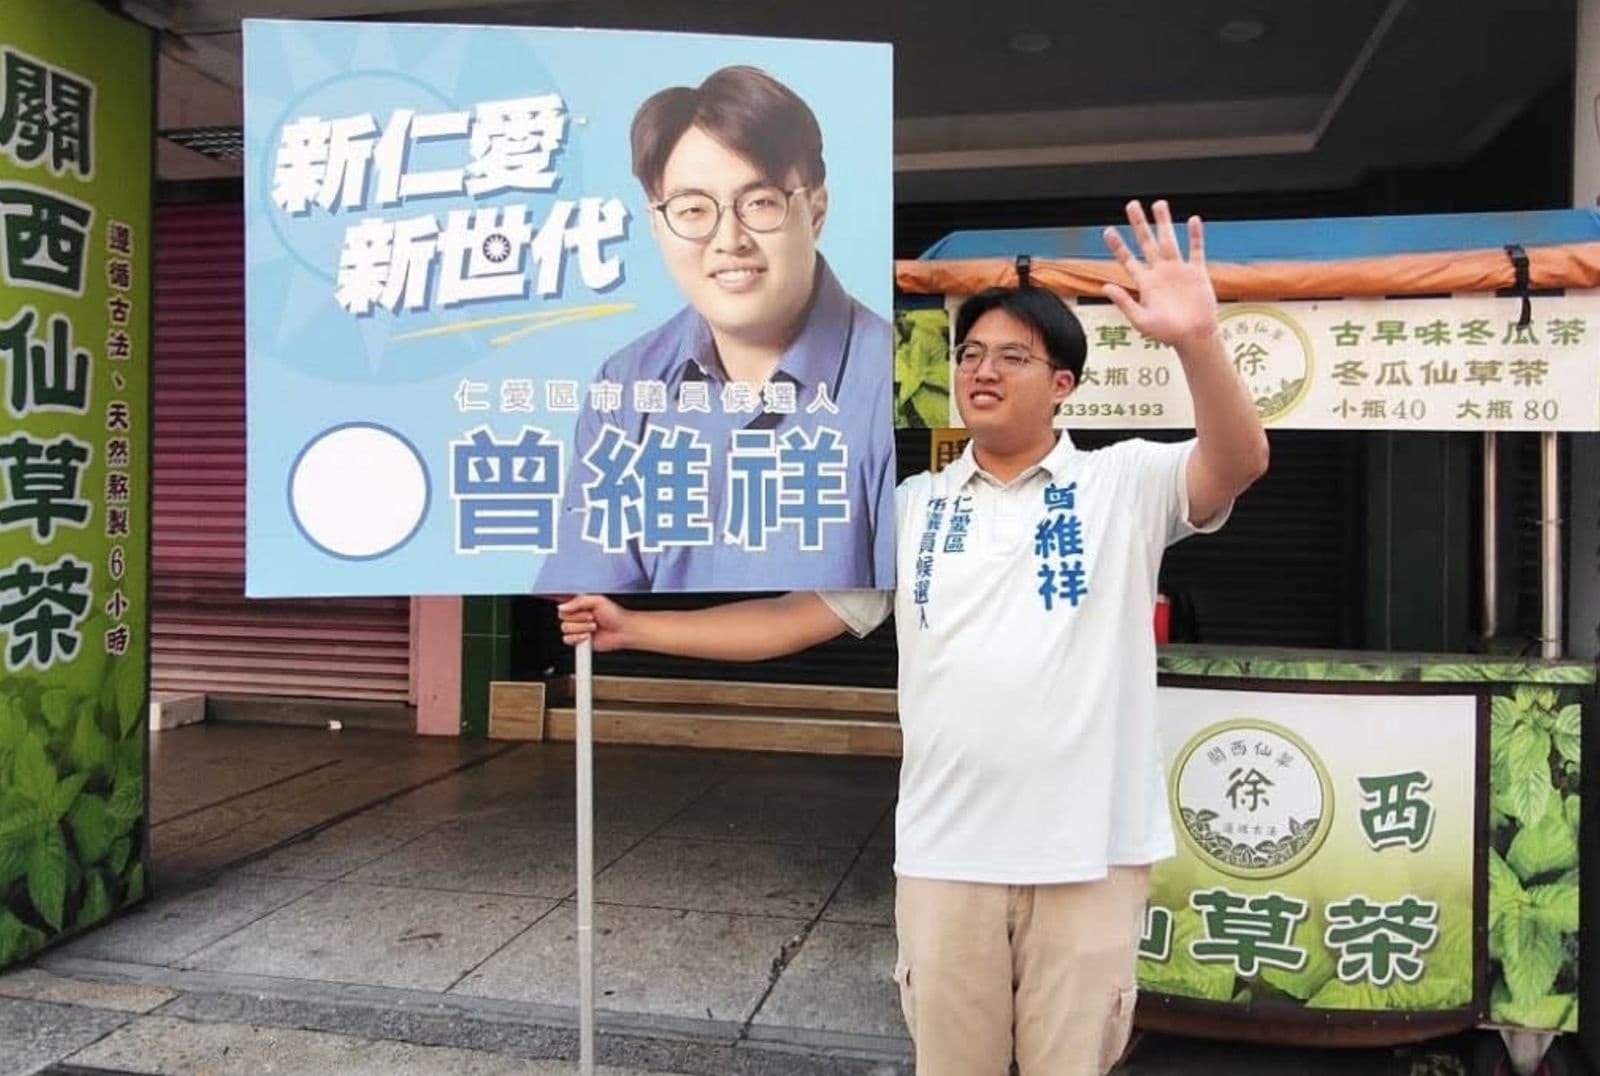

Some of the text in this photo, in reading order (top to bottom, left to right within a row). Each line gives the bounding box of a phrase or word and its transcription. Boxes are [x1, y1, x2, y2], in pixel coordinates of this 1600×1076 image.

[271, 94, 568, 213] 新仁愛
[335, 196, 631, 317] 新世代
[0, 45, 95, 668] 關西仙草茶
[1329, 319, 1586, 347] 古早味冬瓜茶
[1233, 342, 1269, 377] 徐
[1331, 359, 1550, 387] 冬瓜仙草茶
[453, 379, 840, 415] 仁愛區市議員候選人
[1058, 403, 1165, 417] 33934193
[449, 425, 851, 555] 曾維祥
[943, 496, 974, 553] 仁愛區
[1225, 767, 1275, 812] 徐
[1359, 771, 1434, 851] 西
